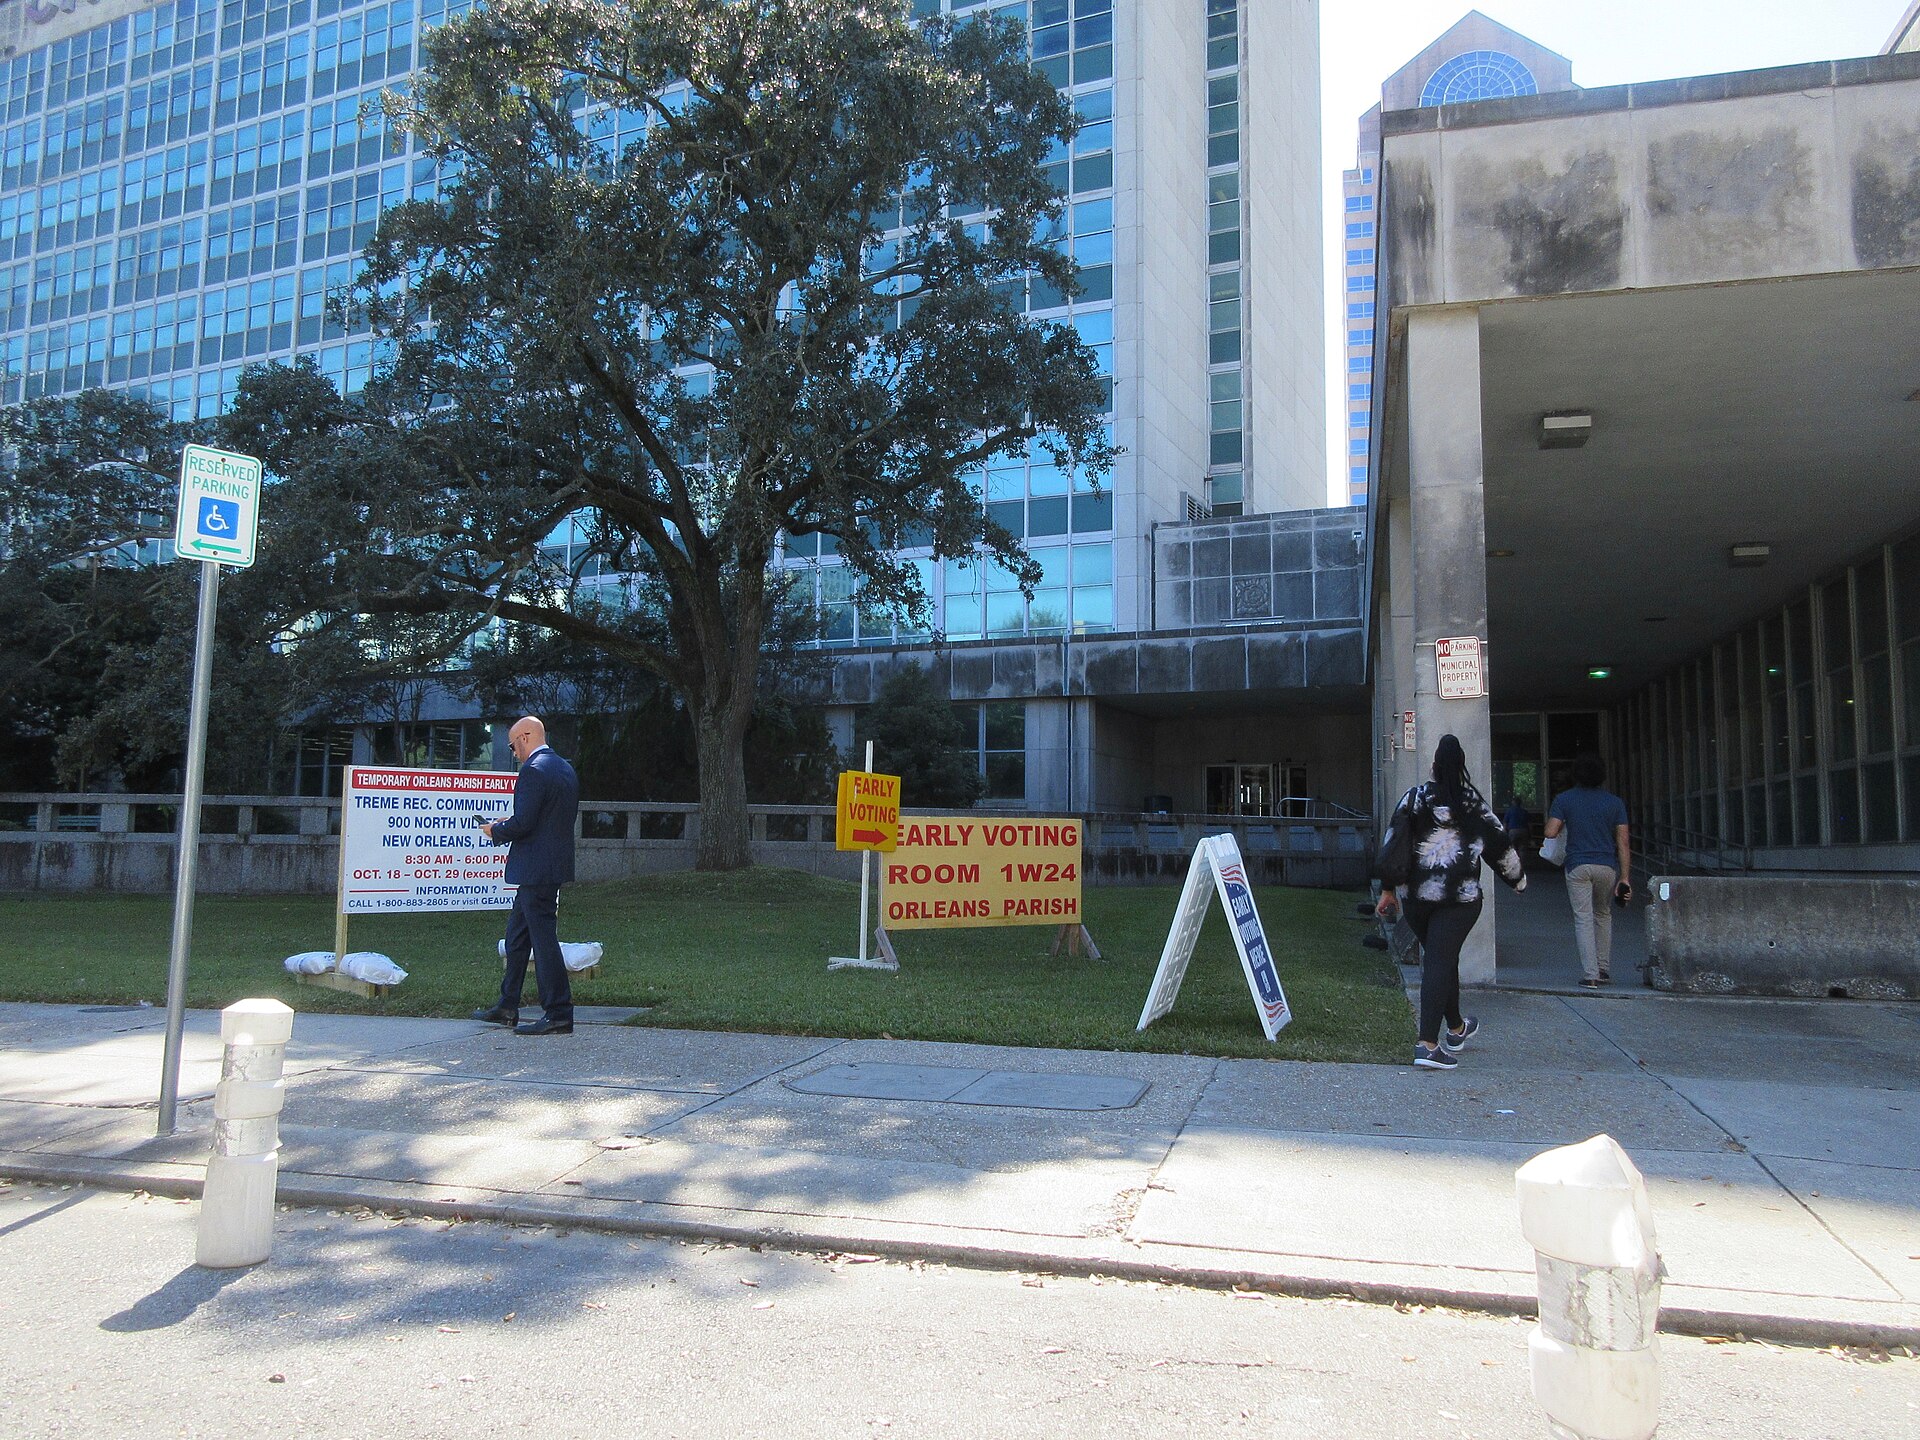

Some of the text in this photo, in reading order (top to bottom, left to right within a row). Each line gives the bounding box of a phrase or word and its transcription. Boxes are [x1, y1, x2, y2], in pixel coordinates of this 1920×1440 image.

[189, 456, 255, 482] RESERVED
[192, 476, 250, 499] PARKING
[1438, 642, 1476, 654] NO PARKING
[1441, 661, 1478, 671] MUNICIPAL
[1442, 672, 1478, 682] PROPERTY
[357, 773, 411, 787] TEMPORARY
[413, 775, 452, 788] ORLEANS
[454, 777, 482, 789] PARISH
[484, 778, 509, 790] EARLY
[854, 776, 895, 798] EARLY
[355, 796, 509, 811] TREME REC. COMMUNITY
[849, 802, 897, 825] VOTING
[388, 816, 411, 828] 900
[414, 817, 456, 829] NORTH
[382, 835, 411, 847] NEW
[415, 835, 475, 849] ORLEANS,
[896, 824, 1077, 847] EARLY VOTING
[405, 855, 431, 865] 8:30
[434, 855, 453, 864] AM
[464, 855, 489, 864] 6:00
[493, 855, 509, 864] PM
[353, 869, 381, 879] OCT.
[386, 869, 401, 879] 18
[414, 869, 441, 879] OCT.
[445, 869, 460, 879] 29
[463, 869, 504, 880] (except
[888, 863, 1077, 885] ROOM 1W24
[416, 885, 498, 895] INFORMATION ?
[348, 899, 373, 908] CALL
[376, 898, 449, 907] 1-800-883-2805
[451, 898, 460, 906] or
[462, 897, 479, 906] visit
[888, 898, 1077, 920] ORLEANS PARISH
[1231, 893, 1251, 919] EARLY
[1249, 944, 1266, 970] HERE
